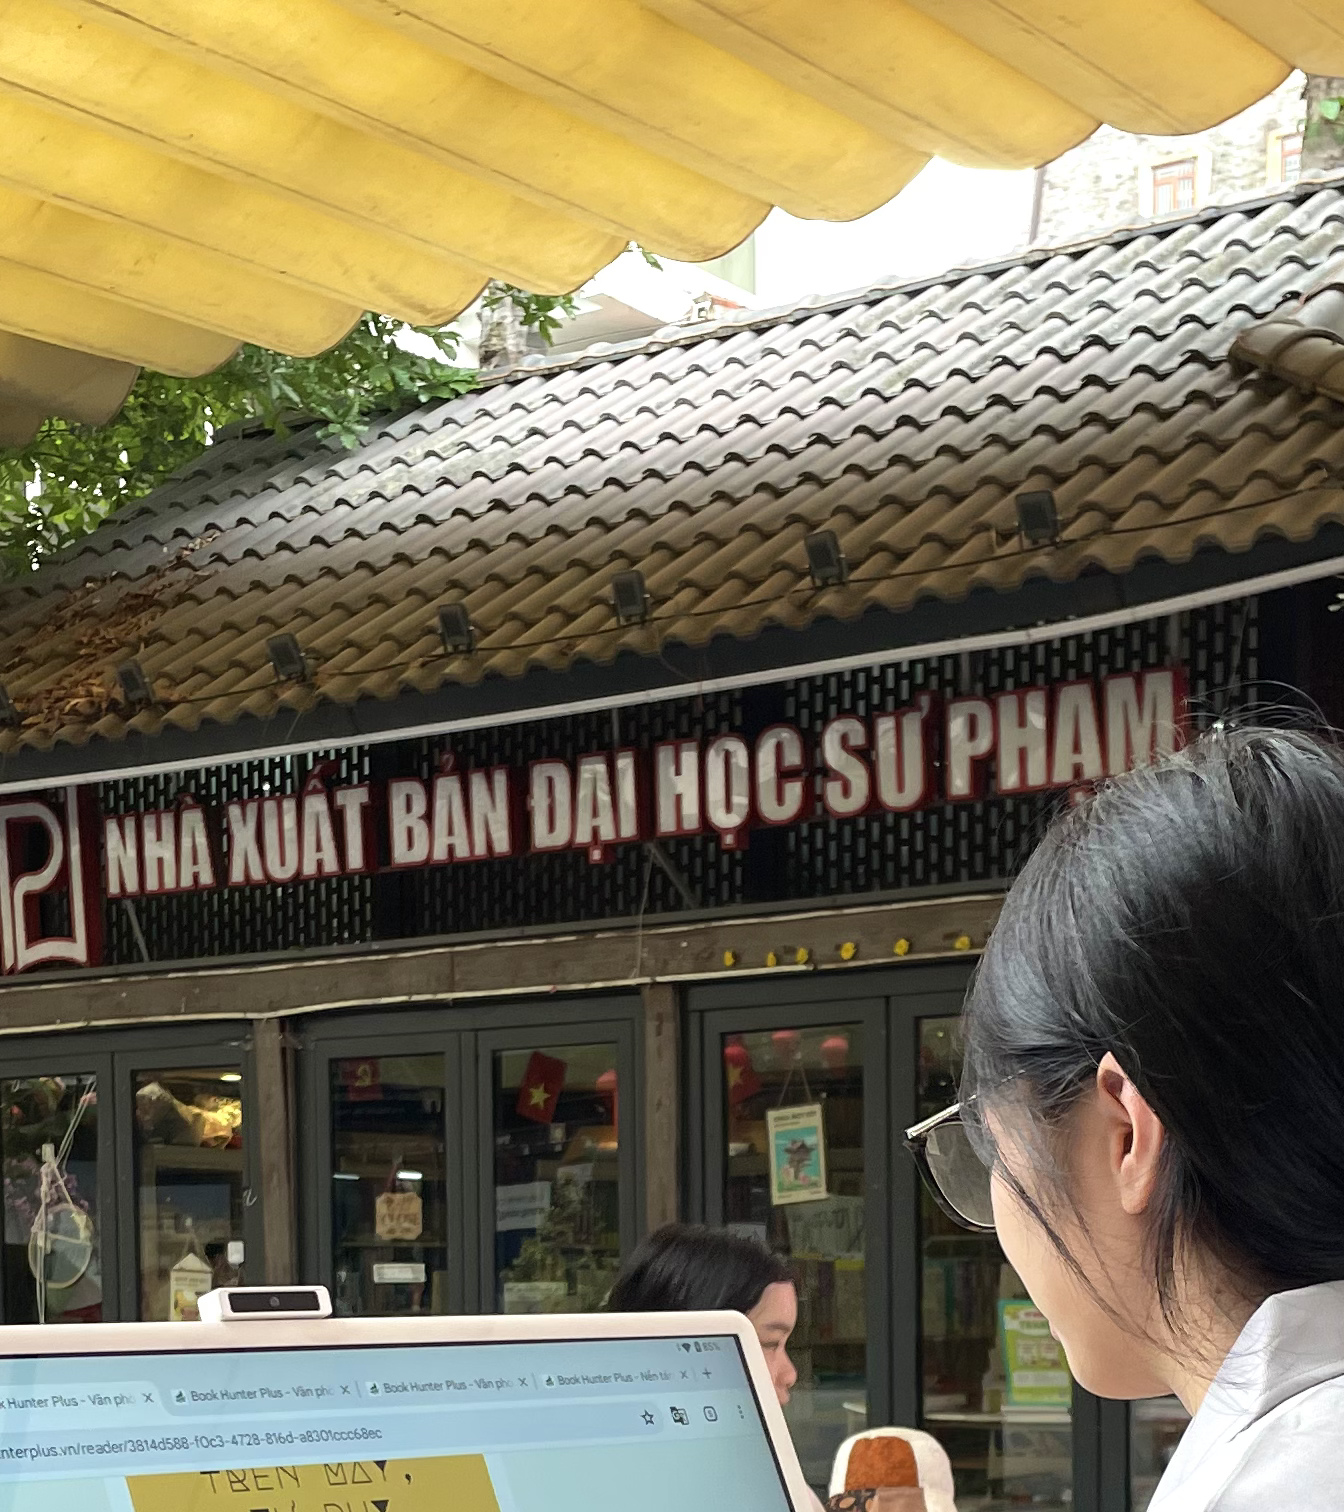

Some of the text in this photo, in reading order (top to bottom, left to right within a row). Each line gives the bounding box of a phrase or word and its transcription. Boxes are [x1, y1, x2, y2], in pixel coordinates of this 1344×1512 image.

[105, 670, 1177, 897] NHÀ XUẤT BẢN ĐẠI HỌC SƯ PHẠM
[558, 1372, 633, 1385] Book Hunter Plus
[384, 1382, 409, 1394] Book
[410, 1381, 443, 1392] Hunter
[446, 1380, 467, 1390] Plus
[6, 1396, 48, 1409] Hunter
[51, 1395, 78, 1407] Plus
[191, 1390, 218, 1402] Book
[219, 1388, 257, 1400] Hunter
[260, 1388, 284, 1399] Plus
